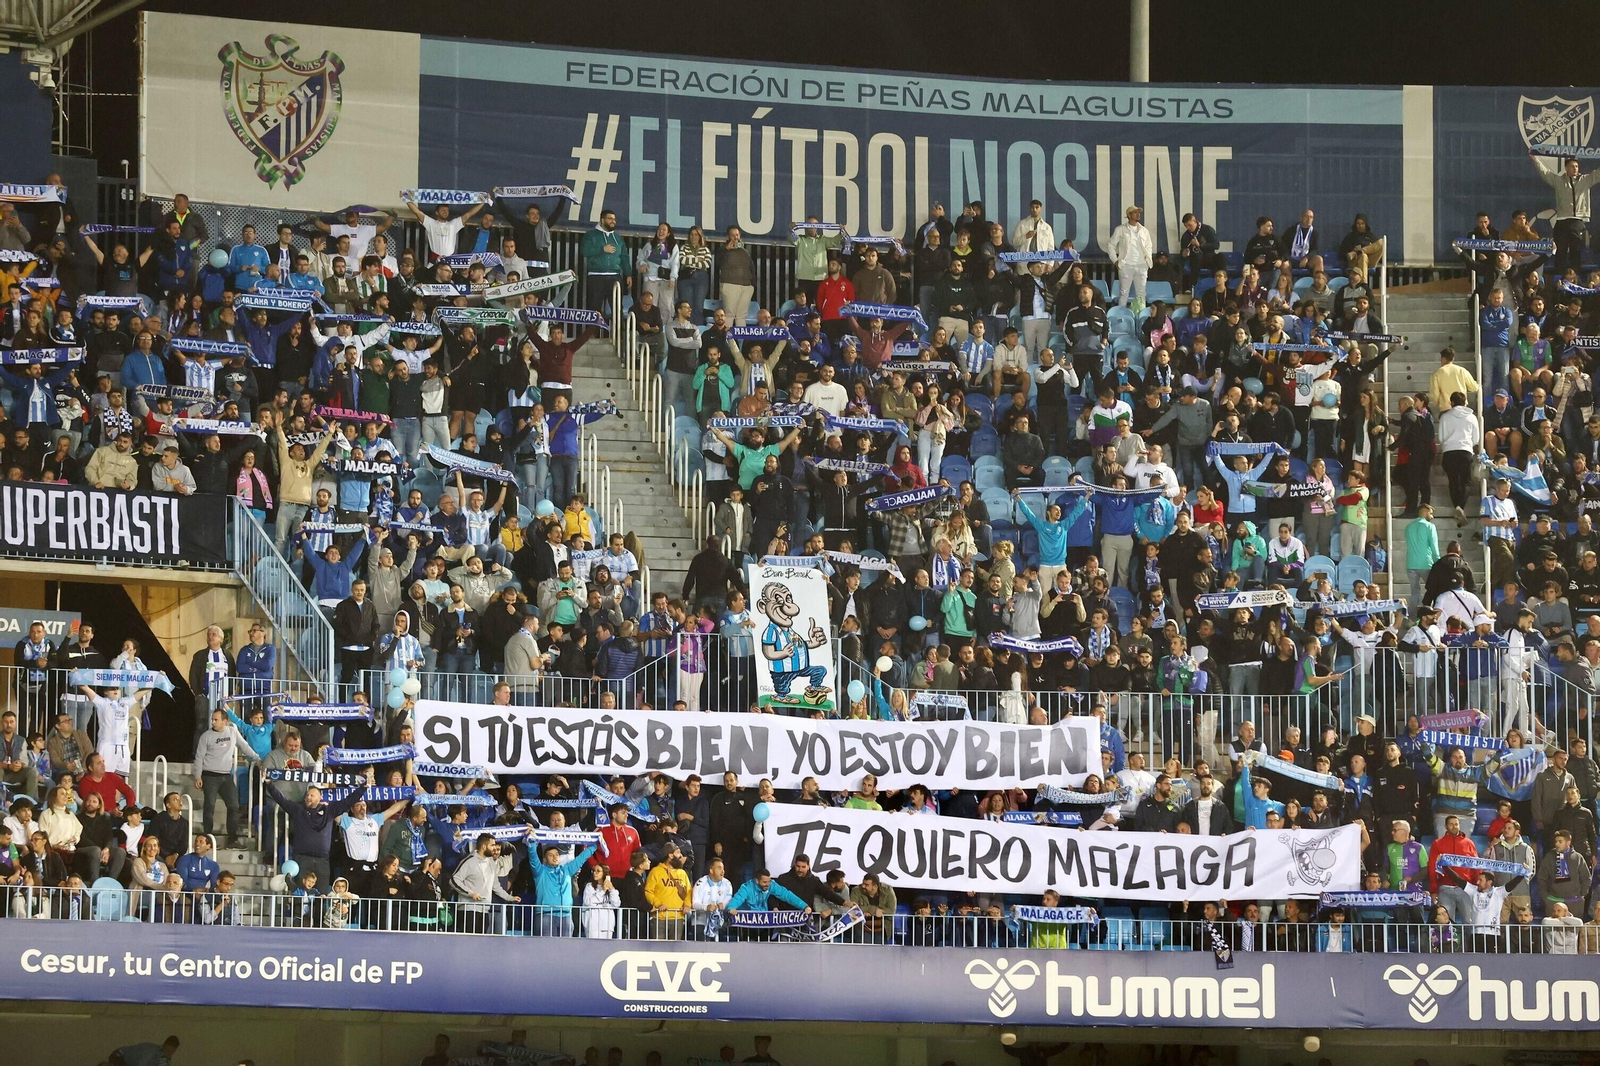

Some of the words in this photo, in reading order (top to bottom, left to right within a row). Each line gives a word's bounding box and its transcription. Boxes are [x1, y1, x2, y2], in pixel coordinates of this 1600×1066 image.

[566, 62, 789, 98] FEDERACIÓN
[801, 80, 845, 102] DE
[857, 81, 970, 110] PEÑAS
[982, 92, 1234, 119] MALAGUISTAS
[420, 190, 471, 202] MALAGA
[559, 309, 597, 322] HINCHAS
[854, 304, 918, 317] MALAGA
[734, 328, 764, 336] MALAGA
[177, 338, 240, 354] MALAGA
[190, 419, 245, 432] MALAGA
[771, 417, 798, 427] SUR
[835, 416, 884, 428] MALAGA
[435, 447, 481, 467] SENTIMIENTOS
[344, 460, 397, 474] MALAGA
[0, 485, 180, 555] UPERBASTI
[306, 521, 362, 531] MALAGA
[402, 523, 437, 531] MALAGA
[832, 552, 887, 568] MALAGA
[1337, 600, 1394, 614] MALAGA
[96, 672, 125, 682] SIEMPRE
[289, 707, 342, 716] MALAGA
[423, 715, 471, 764] SI
[477, 714, 523, 767] TÚ
[526, 715, 641, 768] ESTÁS
[645, 719, 780, 780] BIEN,
[786, 729, 832, 776] YO
[838, 728, 959, 776] ESTOY
[964, 725, 1088, 781] BIEN
[284, 770, 350, 785] GENUINES
[328, 786, 402, 802] SUPBASTI
[545, 832, 591, 841] MALAGA
[777, 820, 850, 873] TE
[857, 824, 1032, 883] QUIERO
[1343, 893, 1399, 903] MALAGA
[735, 912, 770, 925] MALAKA
[1020, 907, 1064, 920] MALAGA
[20, 948, 116, 978] Cesur,
[123, 952, 152, 976] tu
[159, 952, 253, 980] Centro
[258, 955, 343, 983] Oficial
[349, 958, 384, 984] de
[390, 961, 423, 985] FP
[1045, 960, 1276, 1020] hummel
[1467, 965, 1600, 1022] hum
[623, 1004, 708, 1014] CONSTRUCCIONES
